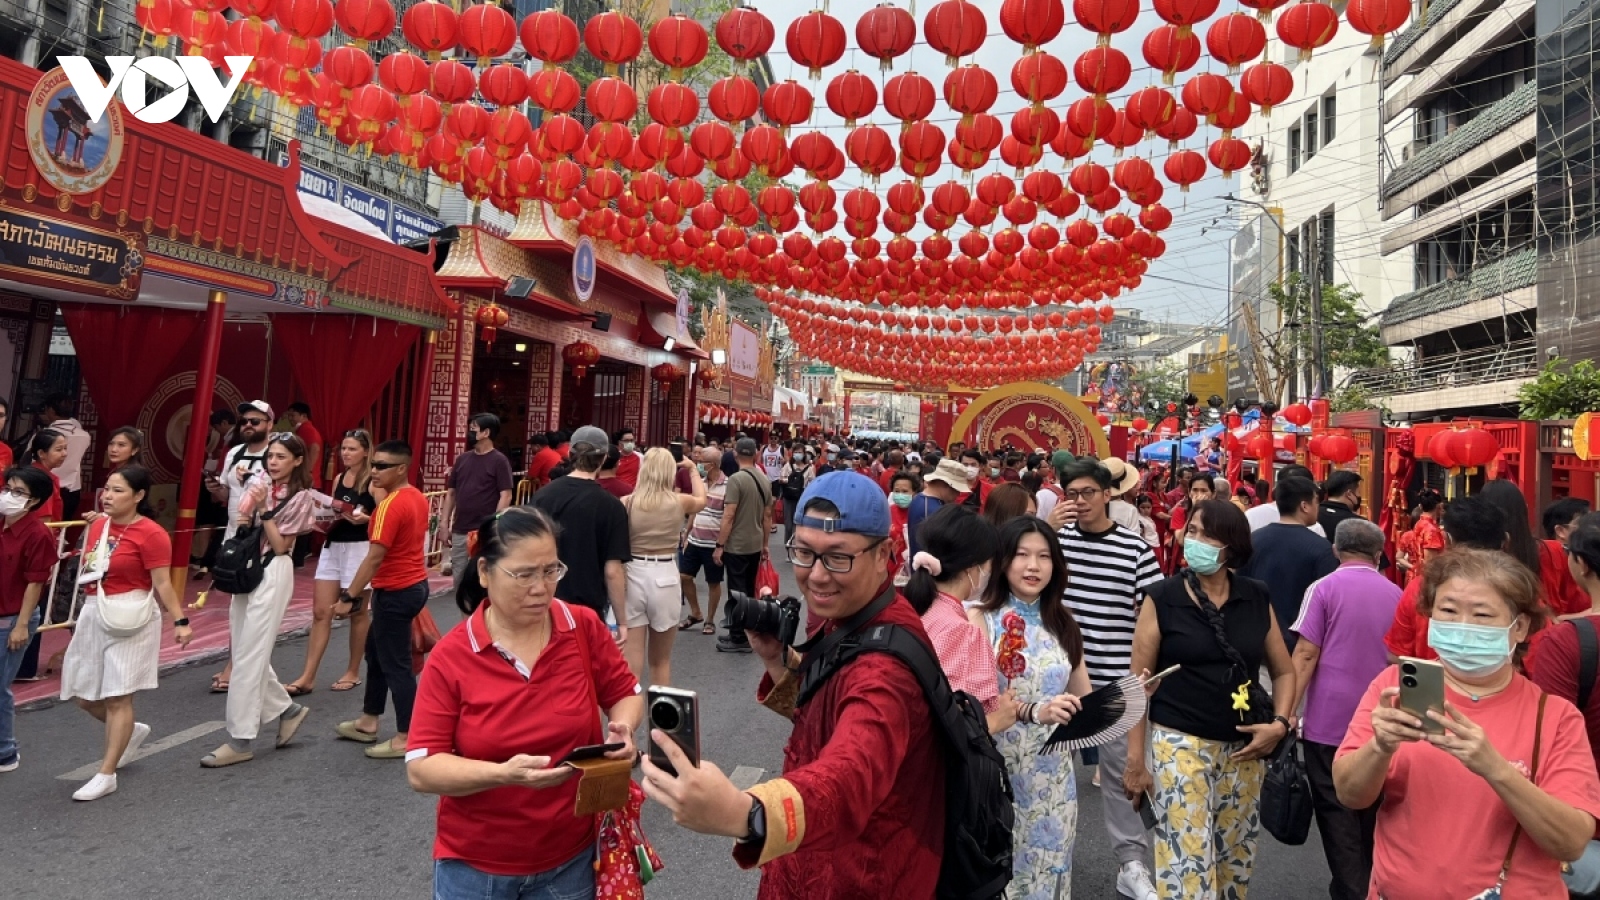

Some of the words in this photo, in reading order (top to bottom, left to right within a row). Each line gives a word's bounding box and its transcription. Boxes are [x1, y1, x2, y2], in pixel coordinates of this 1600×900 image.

[343, 190, 386, 221] จัดยาโดย
[0, 219, 118, 264] สภาวัฒนธรรม
